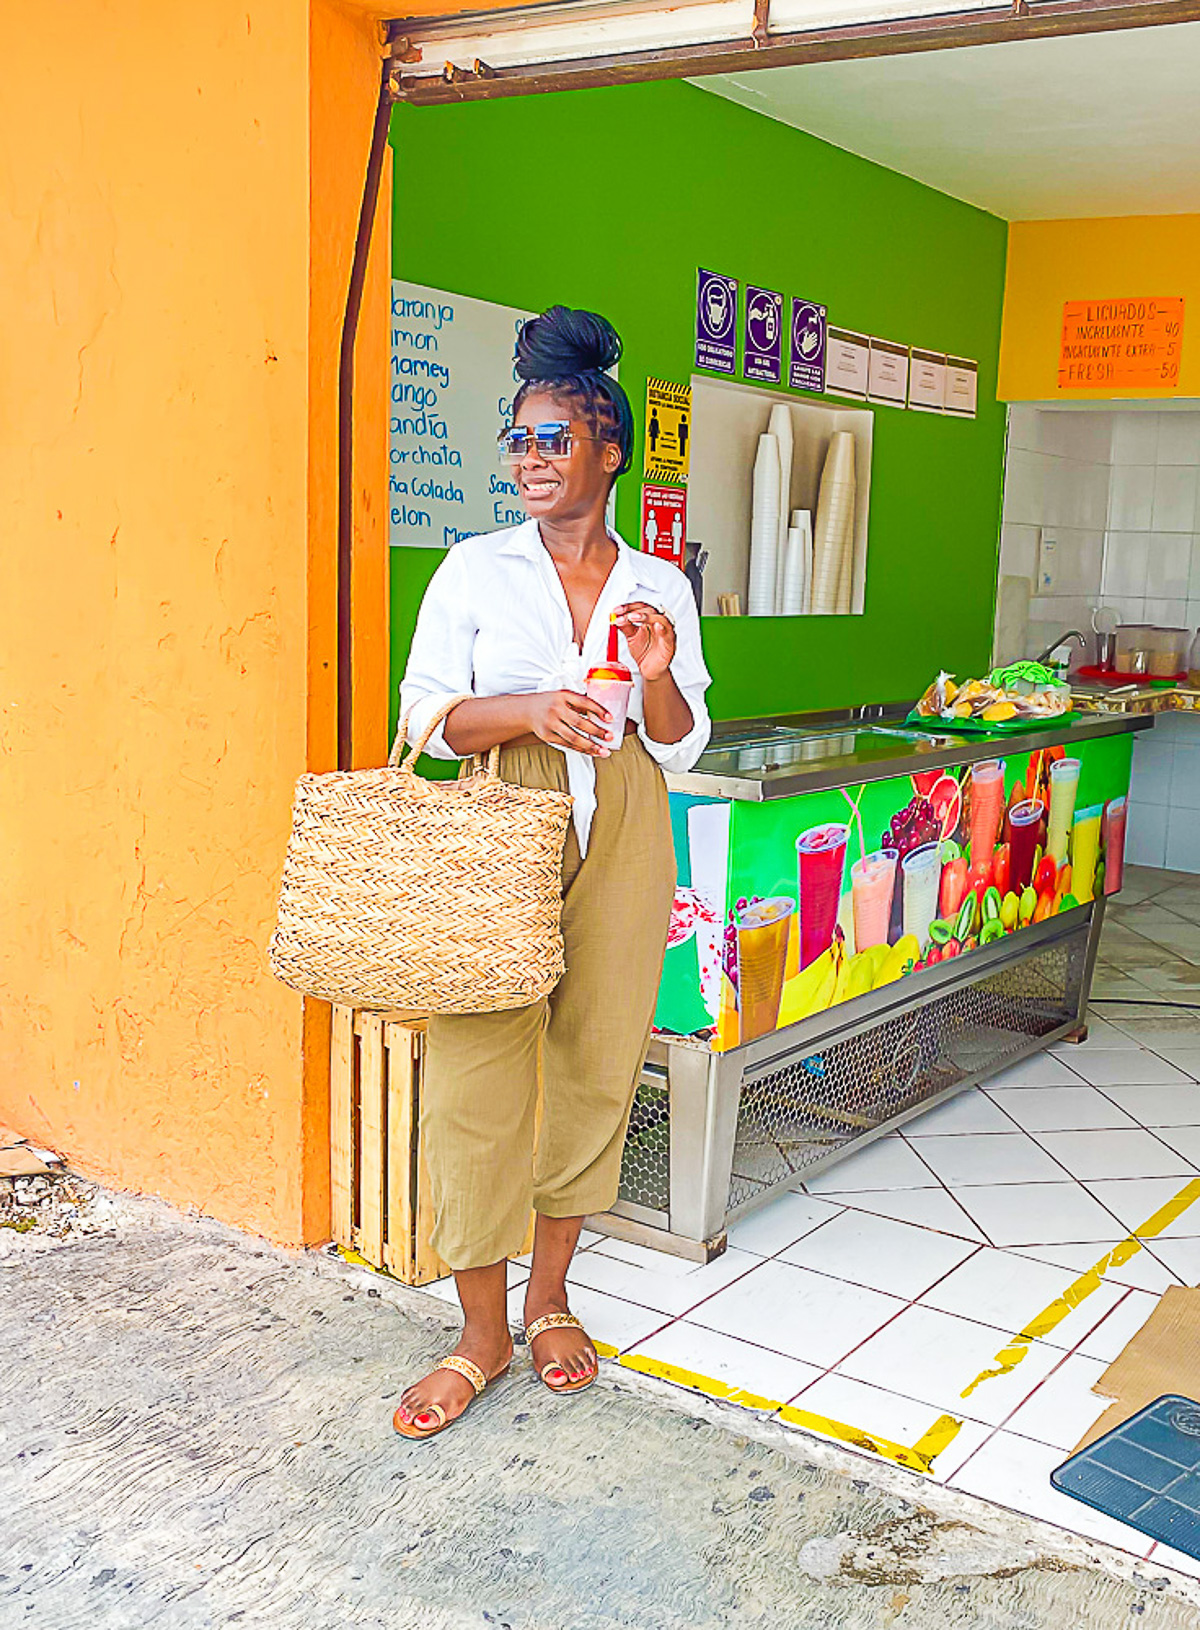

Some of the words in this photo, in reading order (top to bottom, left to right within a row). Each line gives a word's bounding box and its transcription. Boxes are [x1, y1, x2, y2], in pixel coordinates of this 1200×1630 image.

[391, 286, 454, 330] aranja
[1087, 302, 1157, 321] LICUADOS
[391, 329, 438, 351] imon
[1076, 323, 1145, 339] INGREDIENTE
[1165, 322, 1179, 338] 40
[1063, 344, 1122, 359] INGREDIENTE
[1126, 344, 1155, 358] EXTRA
[1069, 363, 1115, 380] FRESA
[1160, 361, 1178, 379] 50
[391, 383, 437, 411] ango
[390, 411, 448, 439] andía
[390, 445, 462, 468] orchata
[411, 477, 464, 504] Colada
[390, 505, 431, 527] elon
